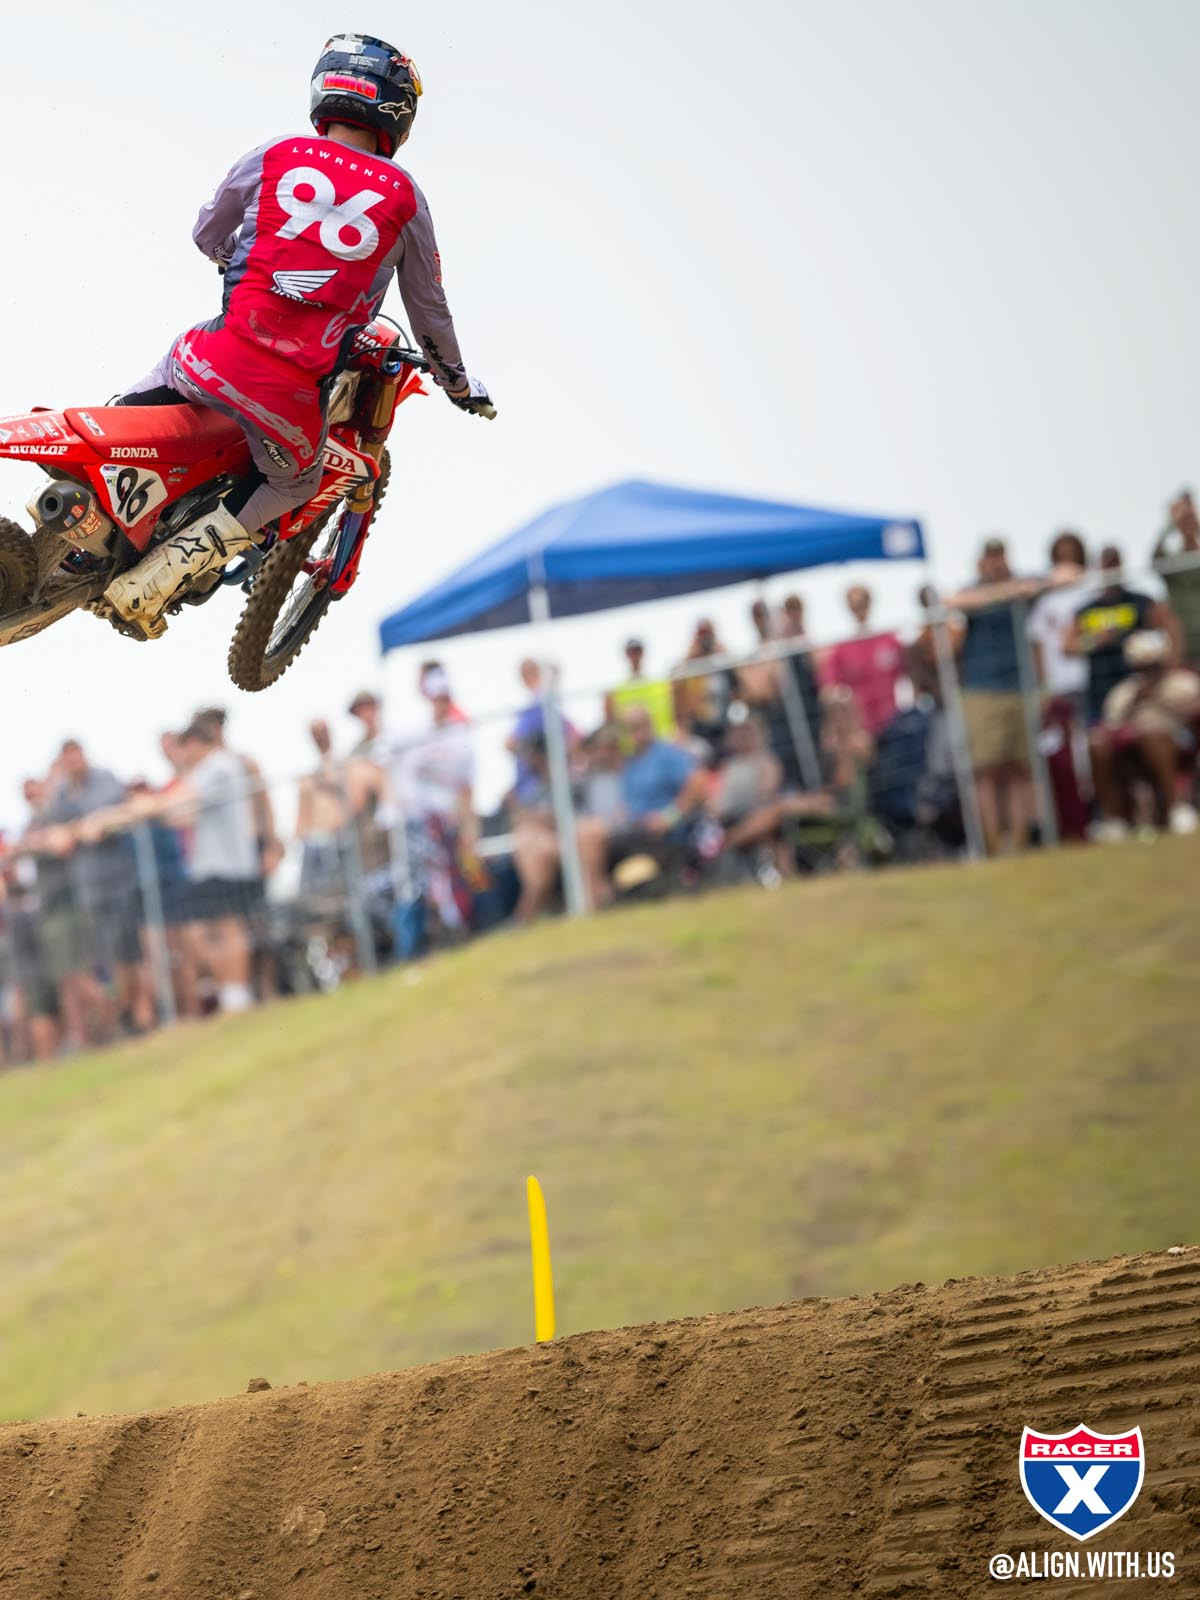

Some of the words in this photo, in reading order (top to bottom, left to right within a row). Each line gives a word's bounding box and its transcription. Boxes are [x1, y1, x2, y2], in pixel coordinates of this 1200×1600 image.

[292, 146, 401, 190] LAWRENCE
[274, 166, 387, 262] 96
[9, 445, 68, 455] DUNLOP
[110, 447, 159, 458] HONDA
[116, 467, 158, 523] 96
